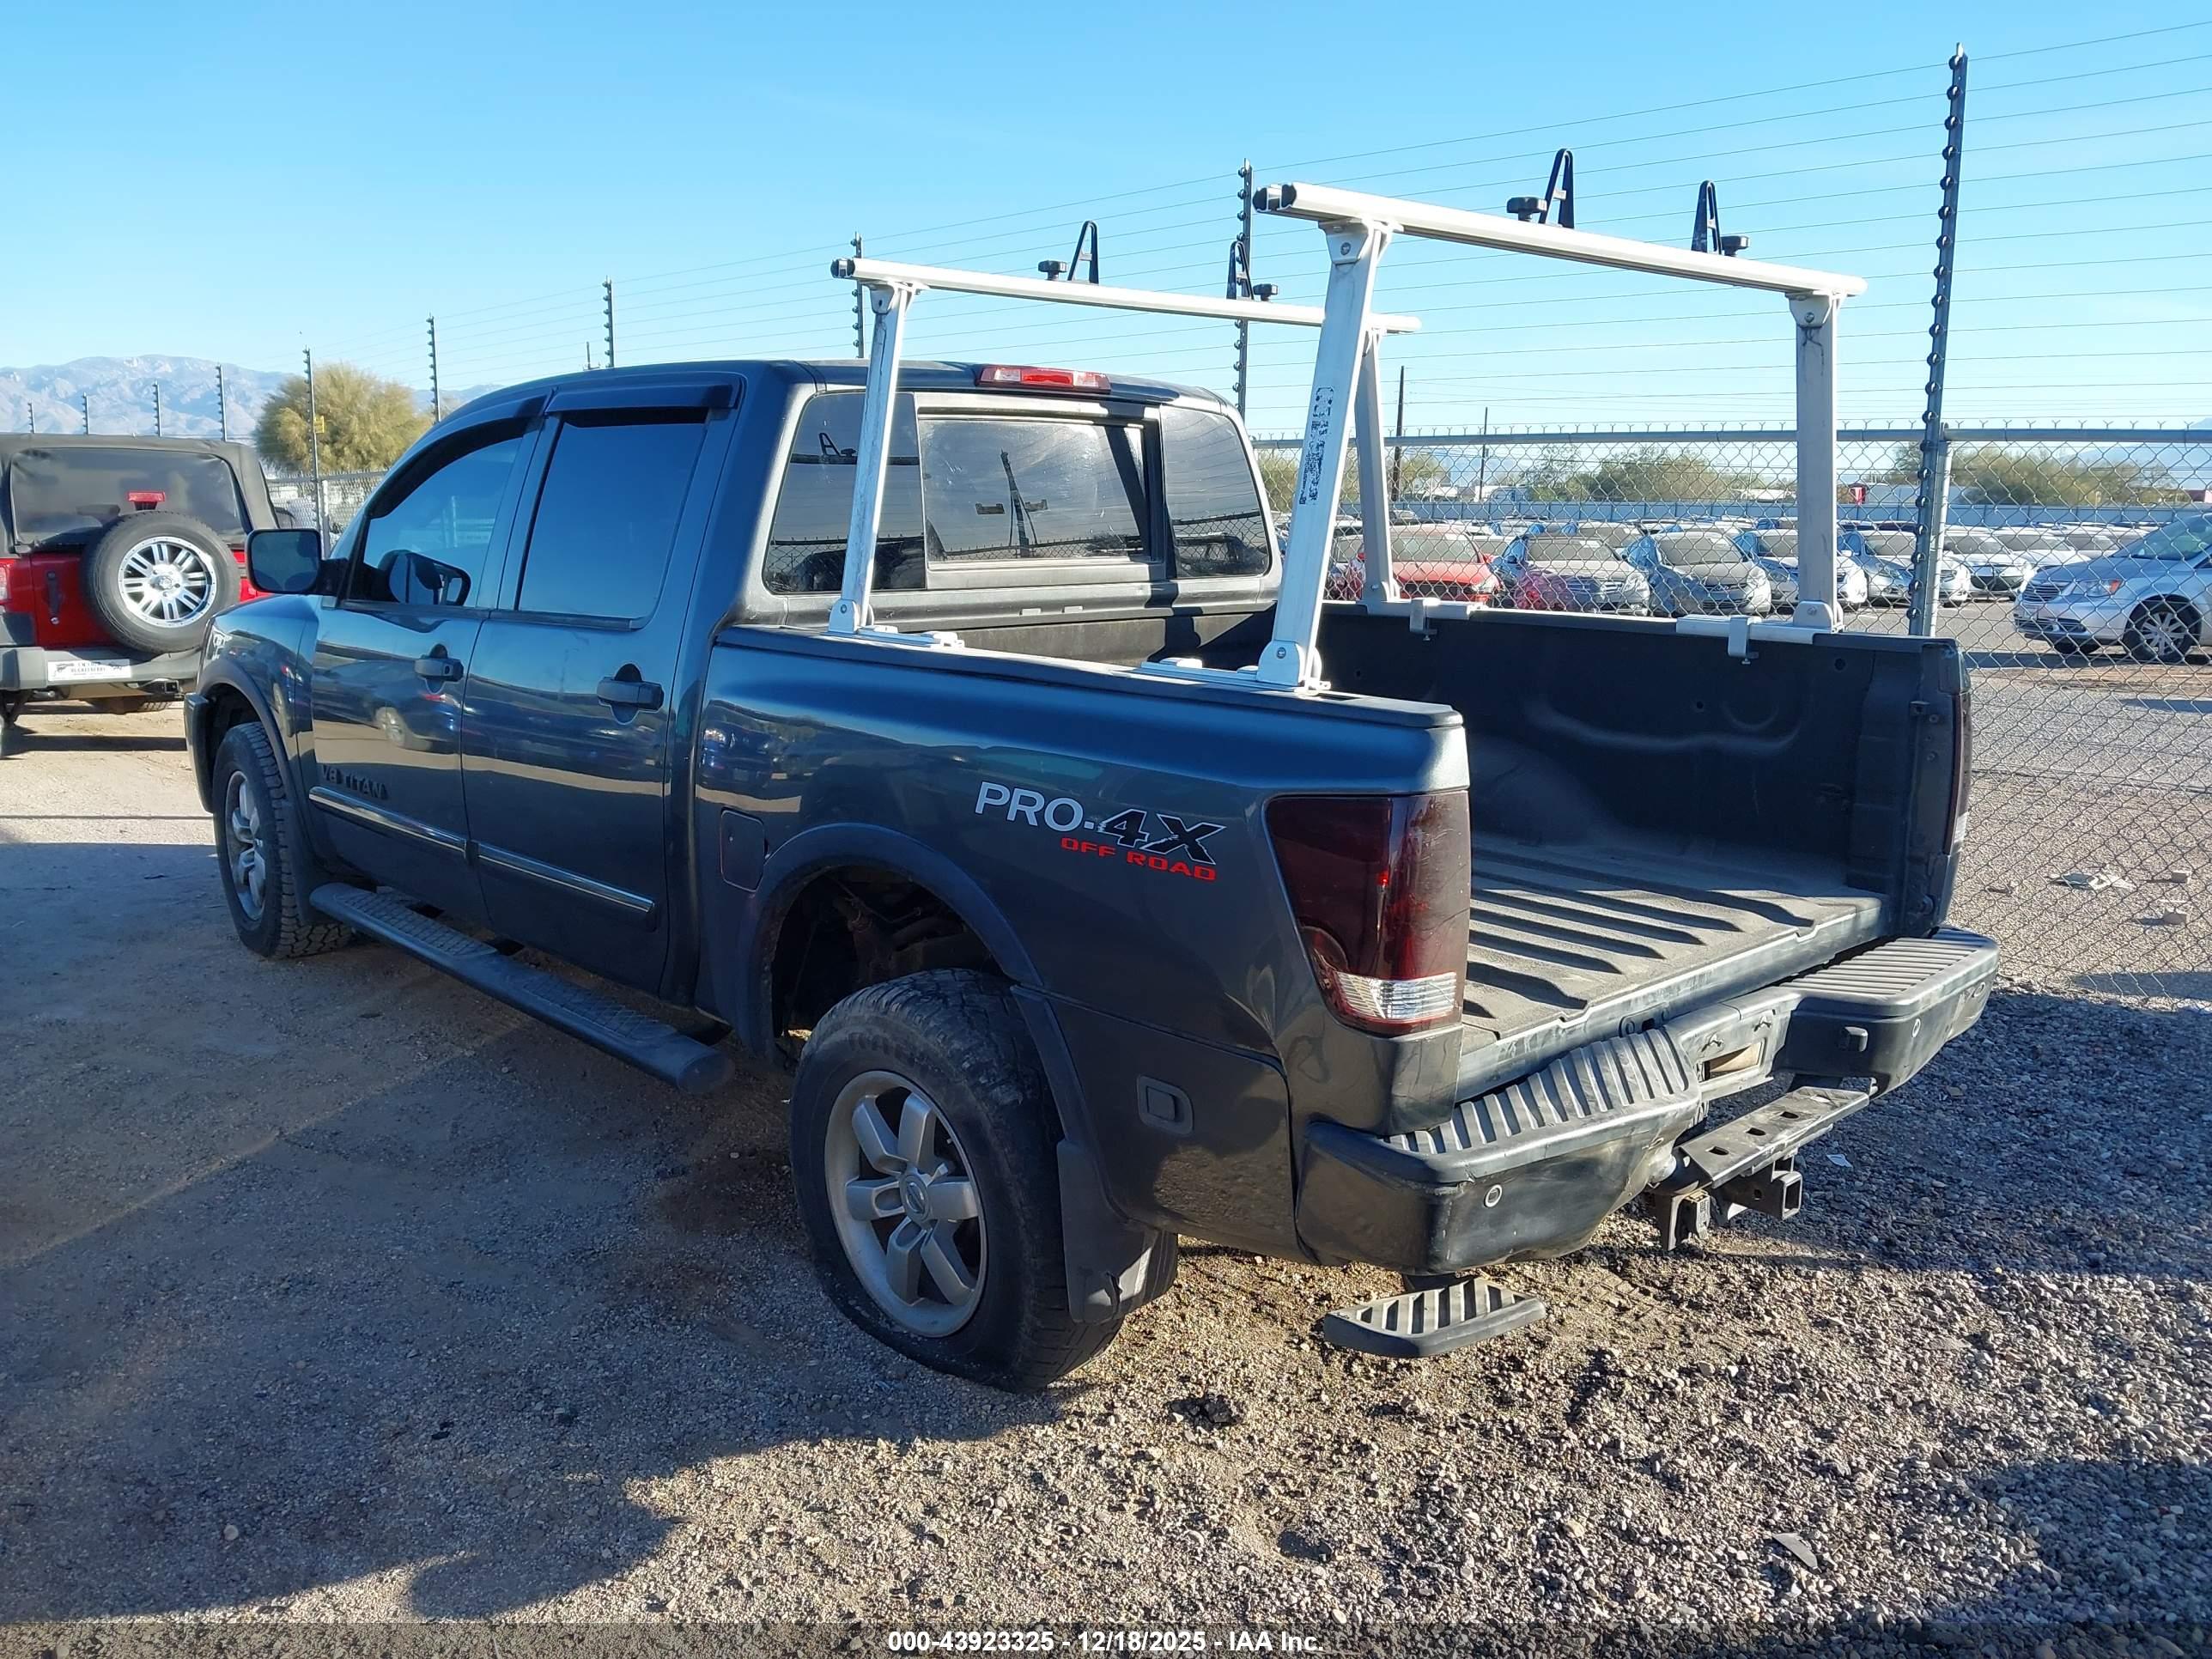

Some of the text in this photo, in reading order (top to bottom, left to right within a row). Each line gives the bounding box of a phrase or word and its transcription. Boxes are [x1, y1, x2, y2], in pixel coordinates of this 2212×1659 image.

[321, 764, 386, 799] V8 TITAN
[1060, 837, 1217, 881] OFF ROAD
